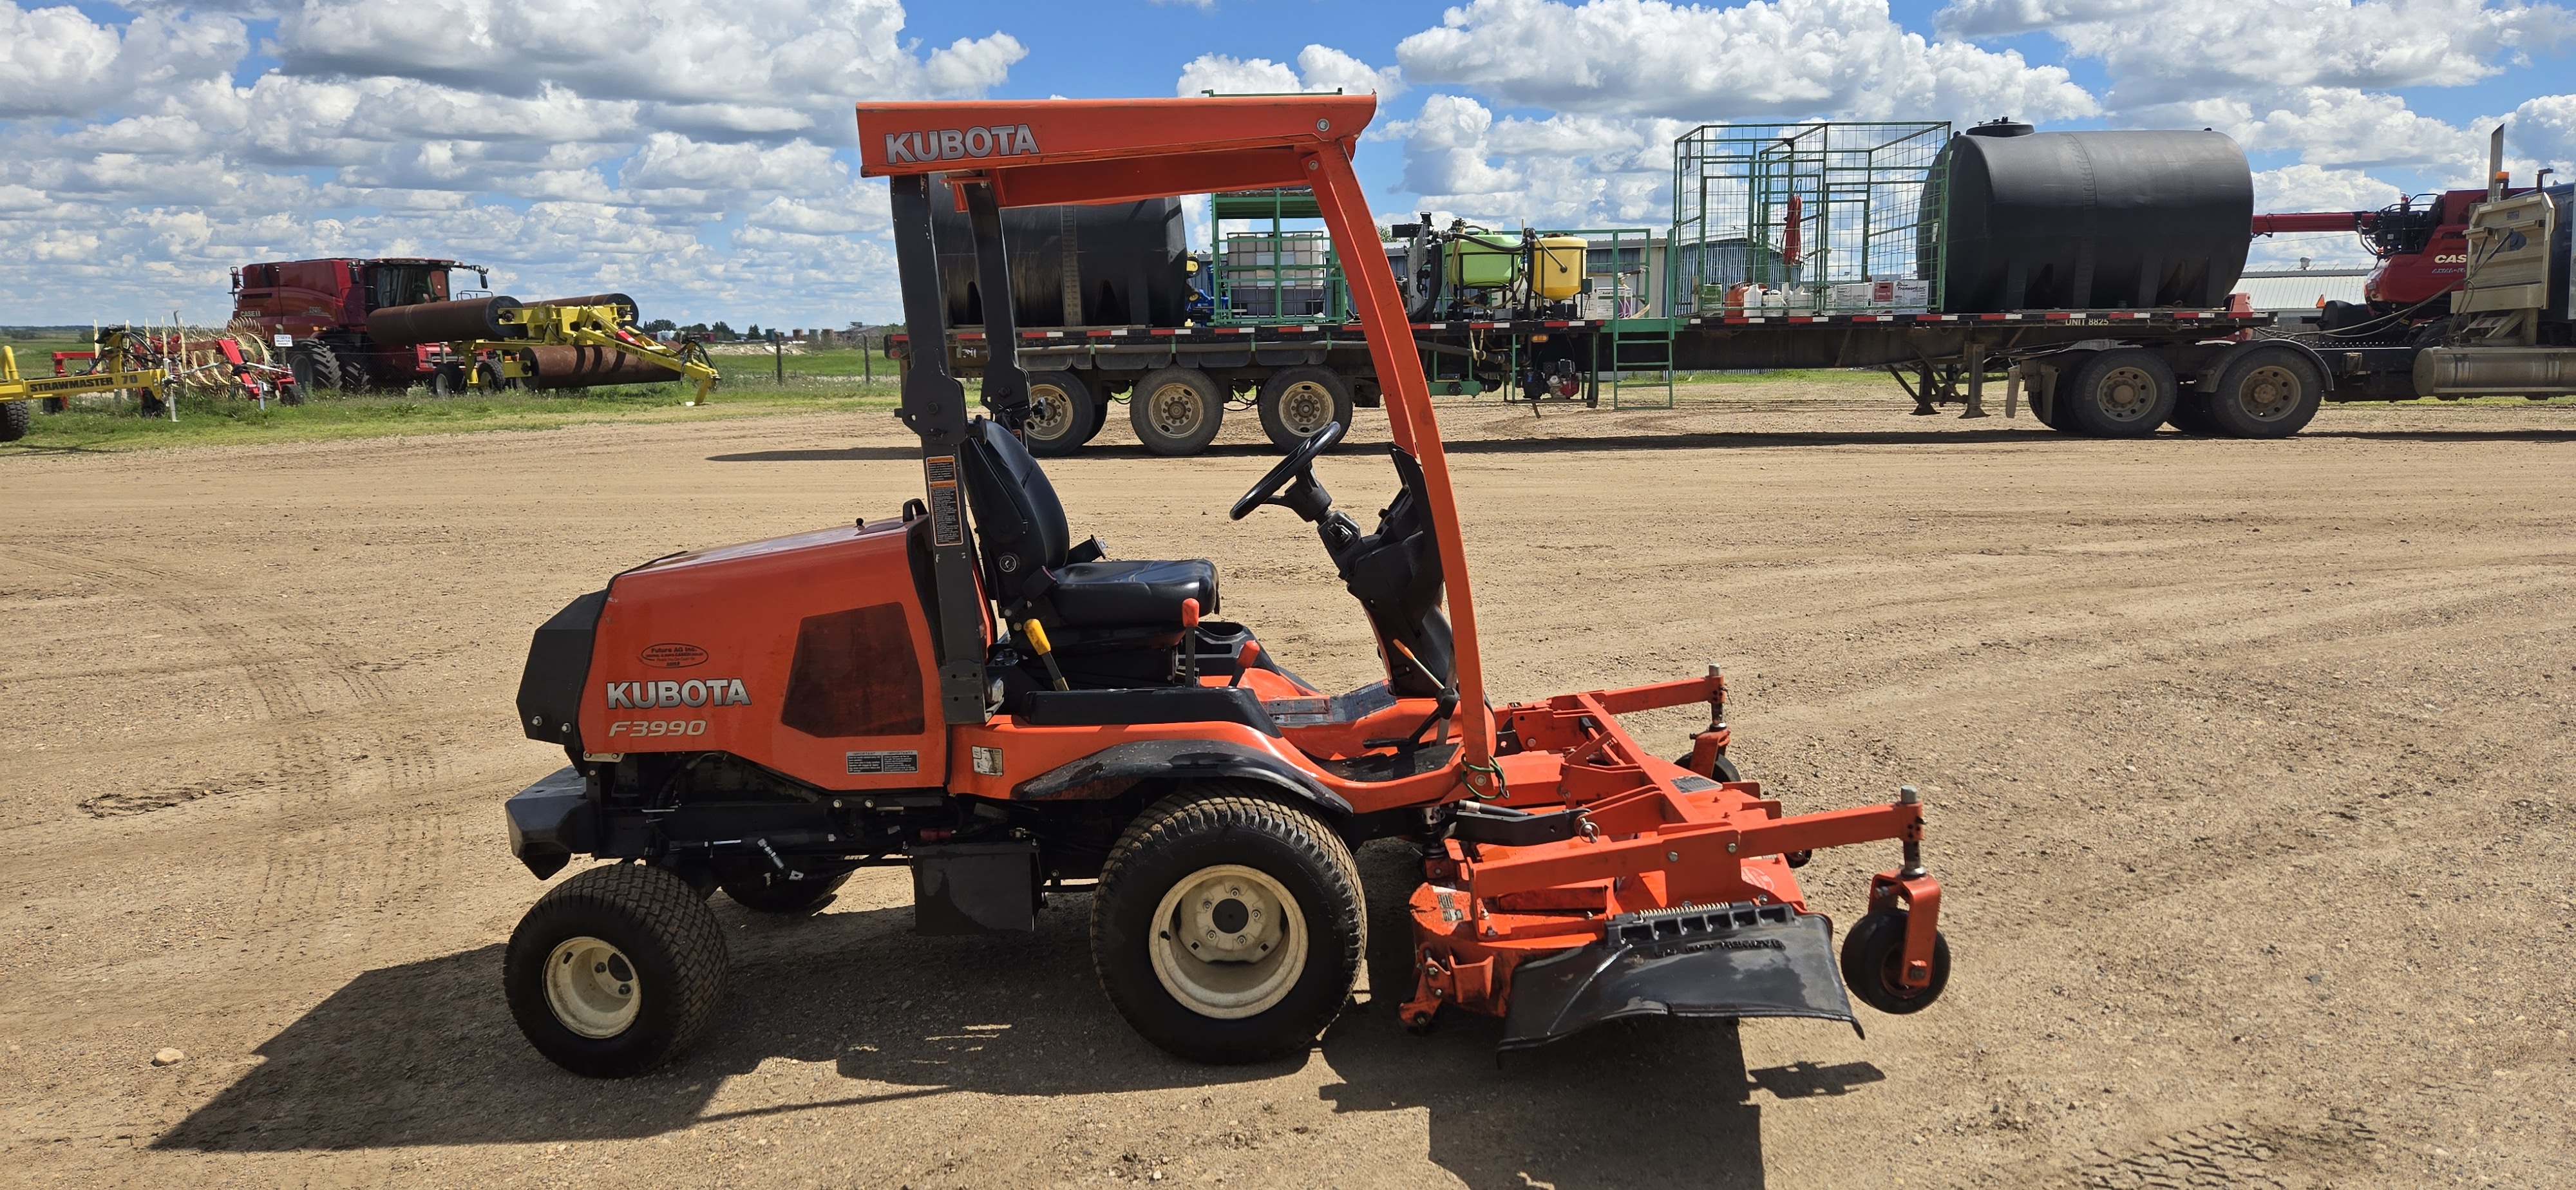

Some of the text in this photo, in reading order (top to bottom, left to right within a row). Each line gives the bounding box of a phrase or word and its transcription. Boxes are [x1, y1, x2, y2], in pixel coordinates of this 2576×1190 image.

[885, 124, 1040, 164] KUBOTA
[30, 374, 138, 392] STRAWMASTER 70
[607, 679, 752, 709] KUBOTA
[609, 720, 707, 737] F3990
